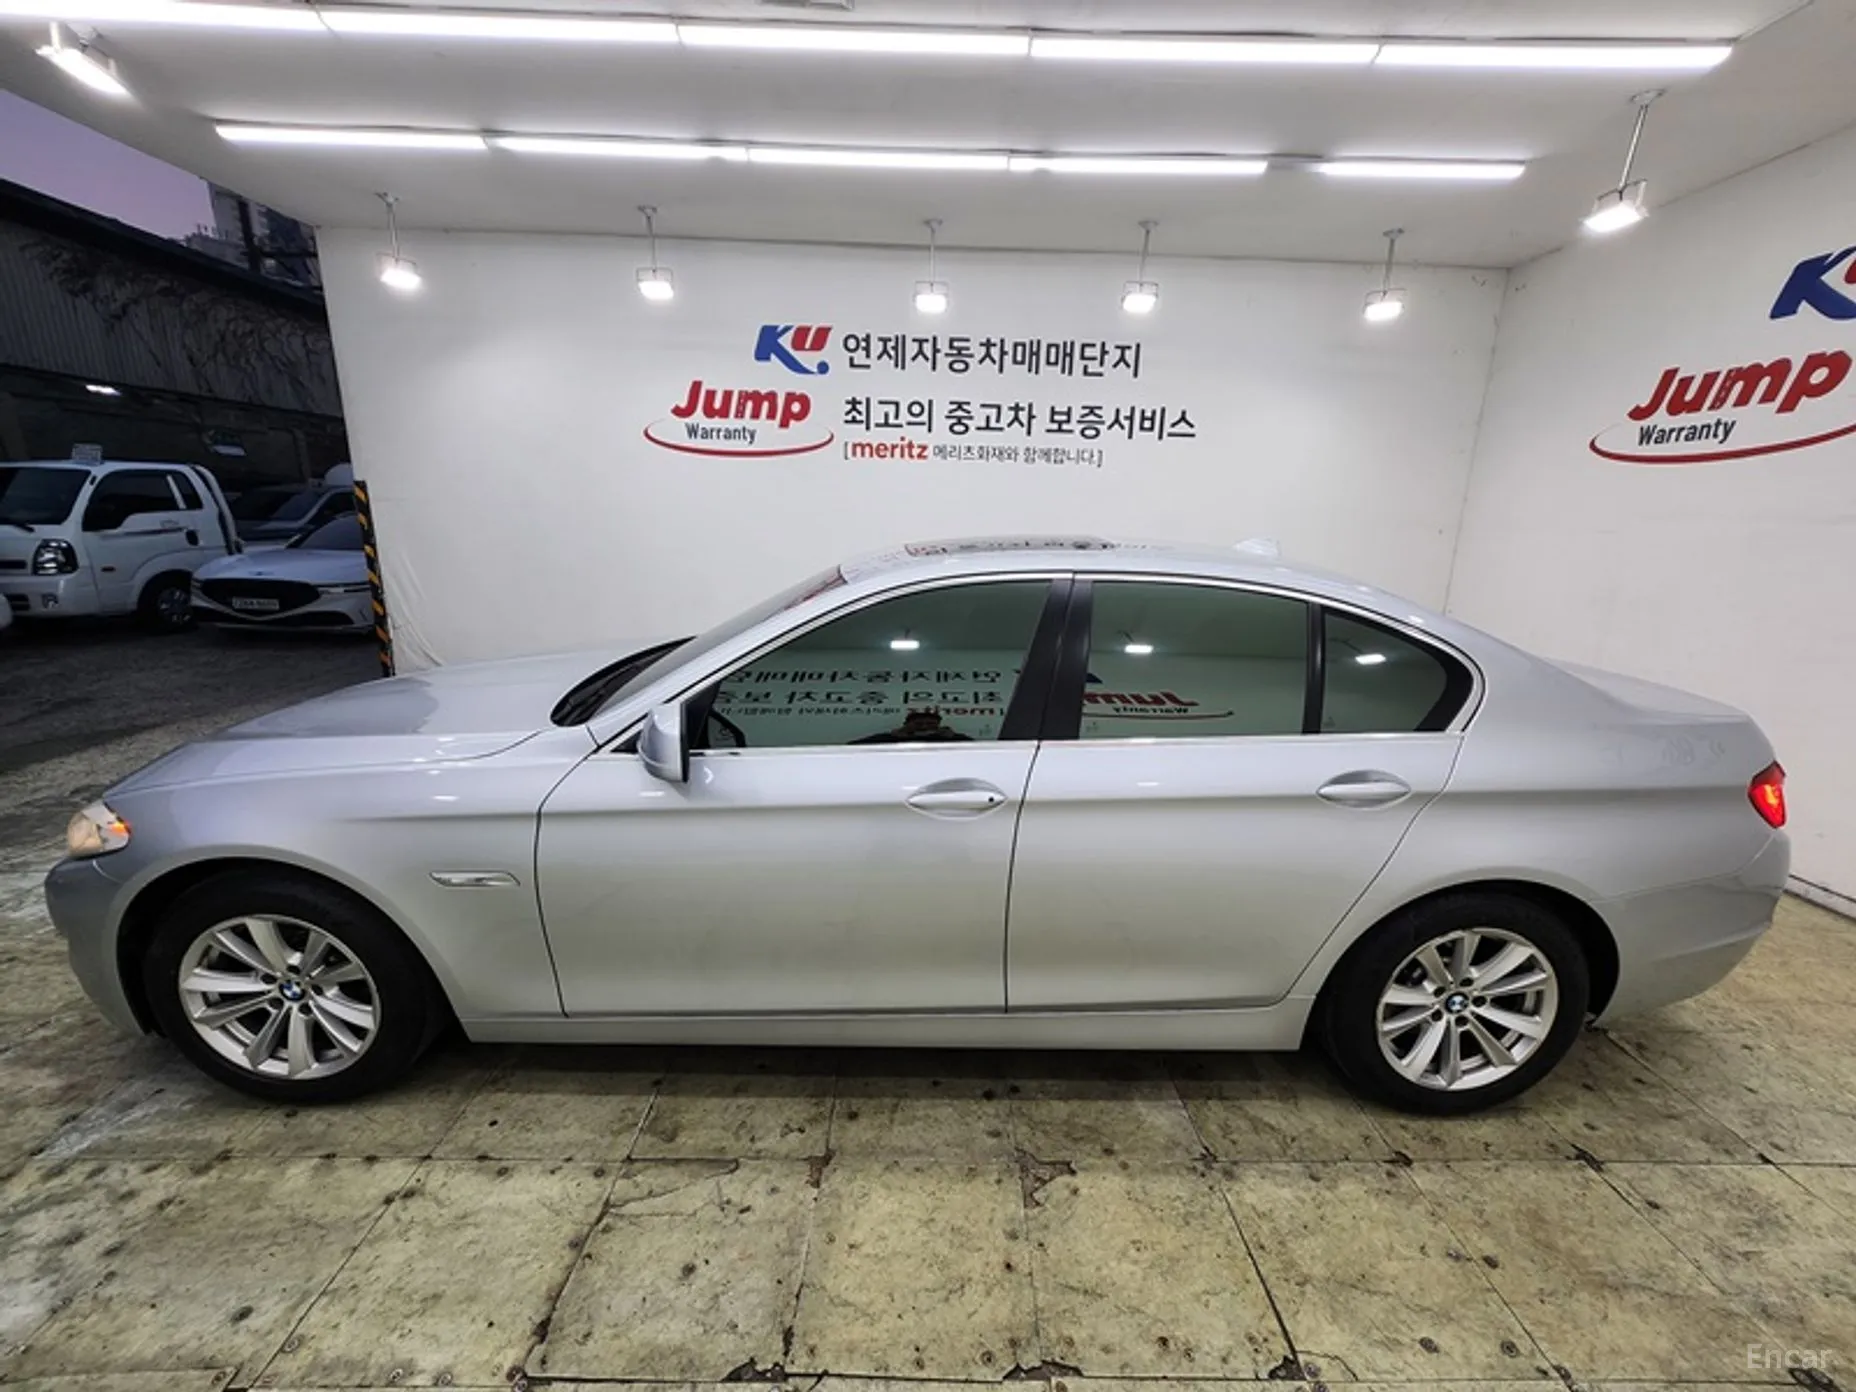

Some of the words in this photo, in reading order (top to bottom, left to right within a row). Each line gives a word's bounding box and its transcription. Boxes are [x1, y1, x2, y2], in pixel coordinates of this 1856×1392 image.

[1769, 246, 1856, 320] K
[843, 333, 1141, 379] 연제자동차매매단지
[671, 380, 811, 429] Jump
[1627, 350, 1852, 421] Jump
[685, 423, 757, 445] Warranty
[843, 396, 934, 434] 최고의
[944, 400, 1036, 437] 중고차
[1045, 405, 1196, 441] 보증서비스
[1637, 418, 1737, 446] Warranty
